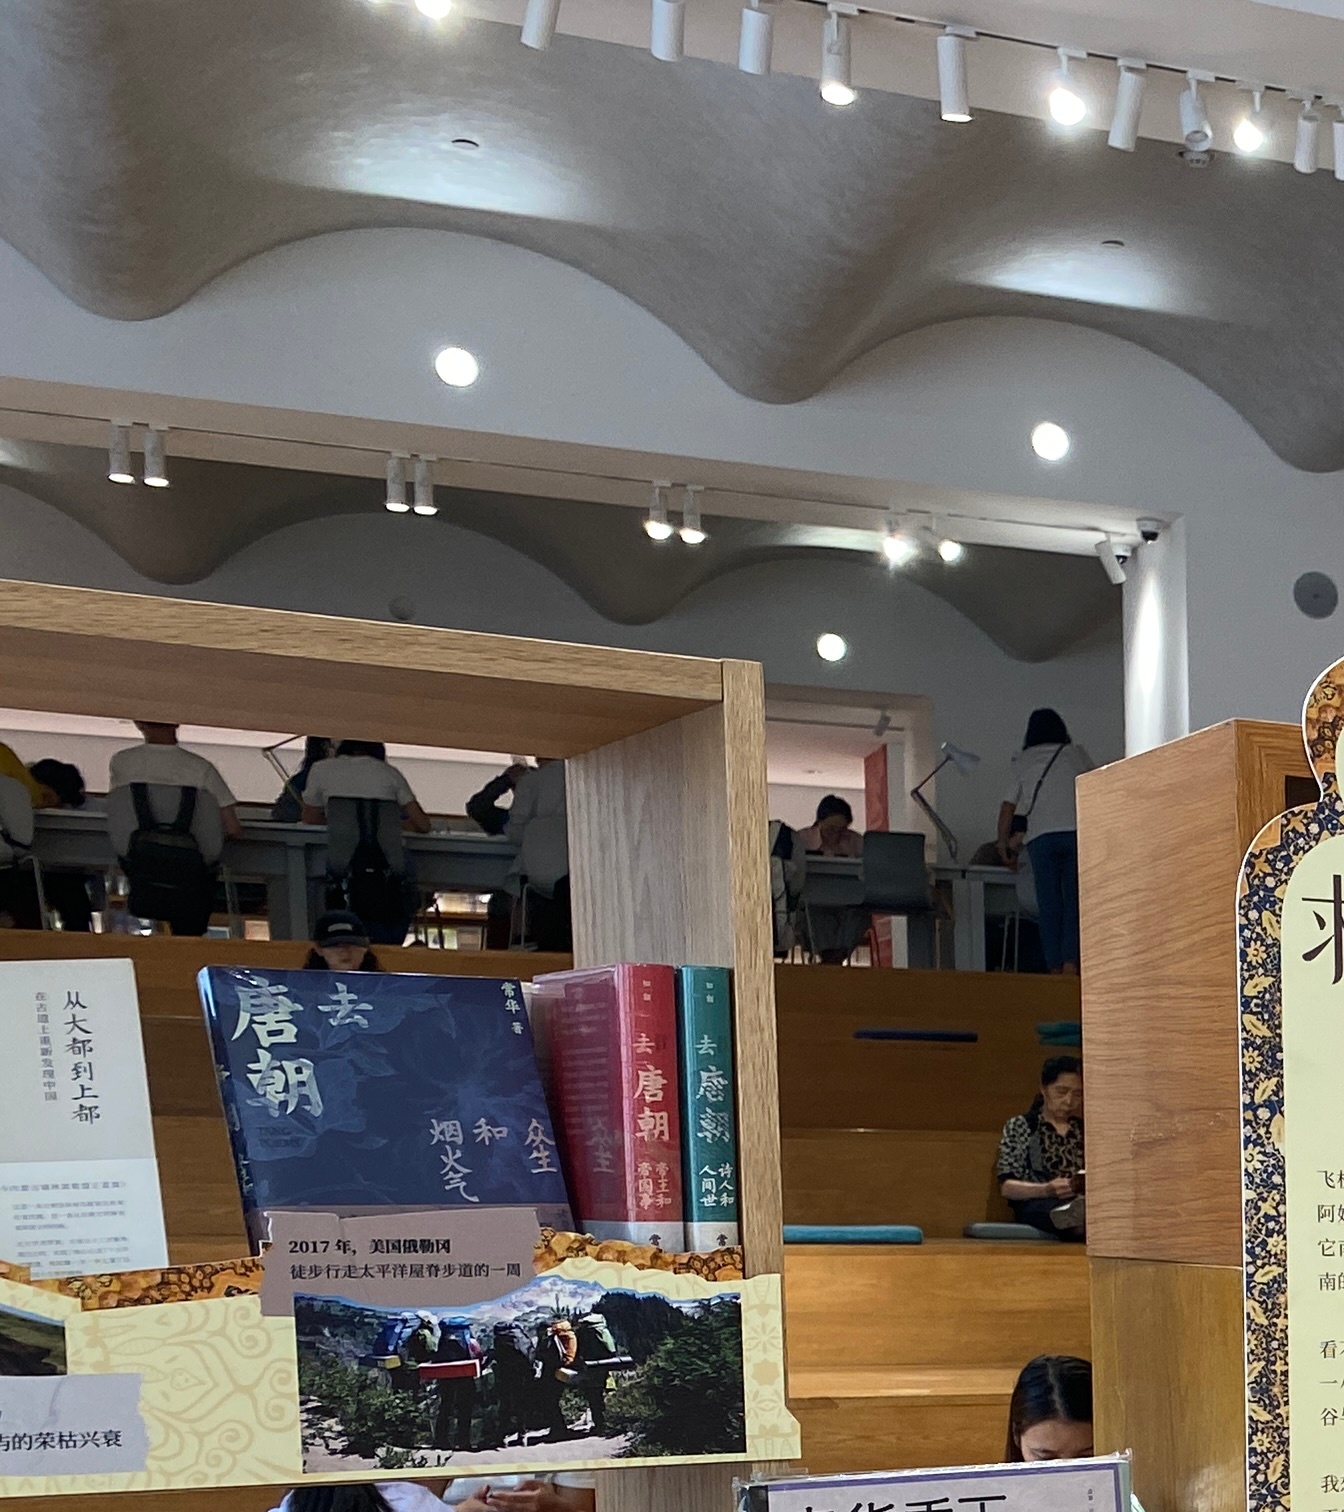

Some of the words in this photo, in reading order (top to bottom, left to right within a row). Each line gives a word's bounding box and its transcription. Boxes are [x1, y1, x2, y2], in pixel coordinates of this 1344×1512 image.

[317, 982, 374, 1029] 去
[501, 981, 521, 1014] 常华
[34, 991, 59, 1103] 在古道上重新发现中国
[62, 990, 102, 1127] 从大都到上都
[230, 975, 324, 1119] 唐朝
[632, 1033, 670, 1144] 去唐朝
[694, 1034, 731, 1144] 去唐朝
[472, 1117, 508, 1146] 和
[524, 1118, 557, 1174] 众生
[429, 1118, 480, 1203] 烟火气
[699, 1163, 718, 1208] 人间世
[289, 1238, 331, 1254] 2017
[289, 1263, 522, 1281] 徒步行走太平洋屋脊步道的一周
